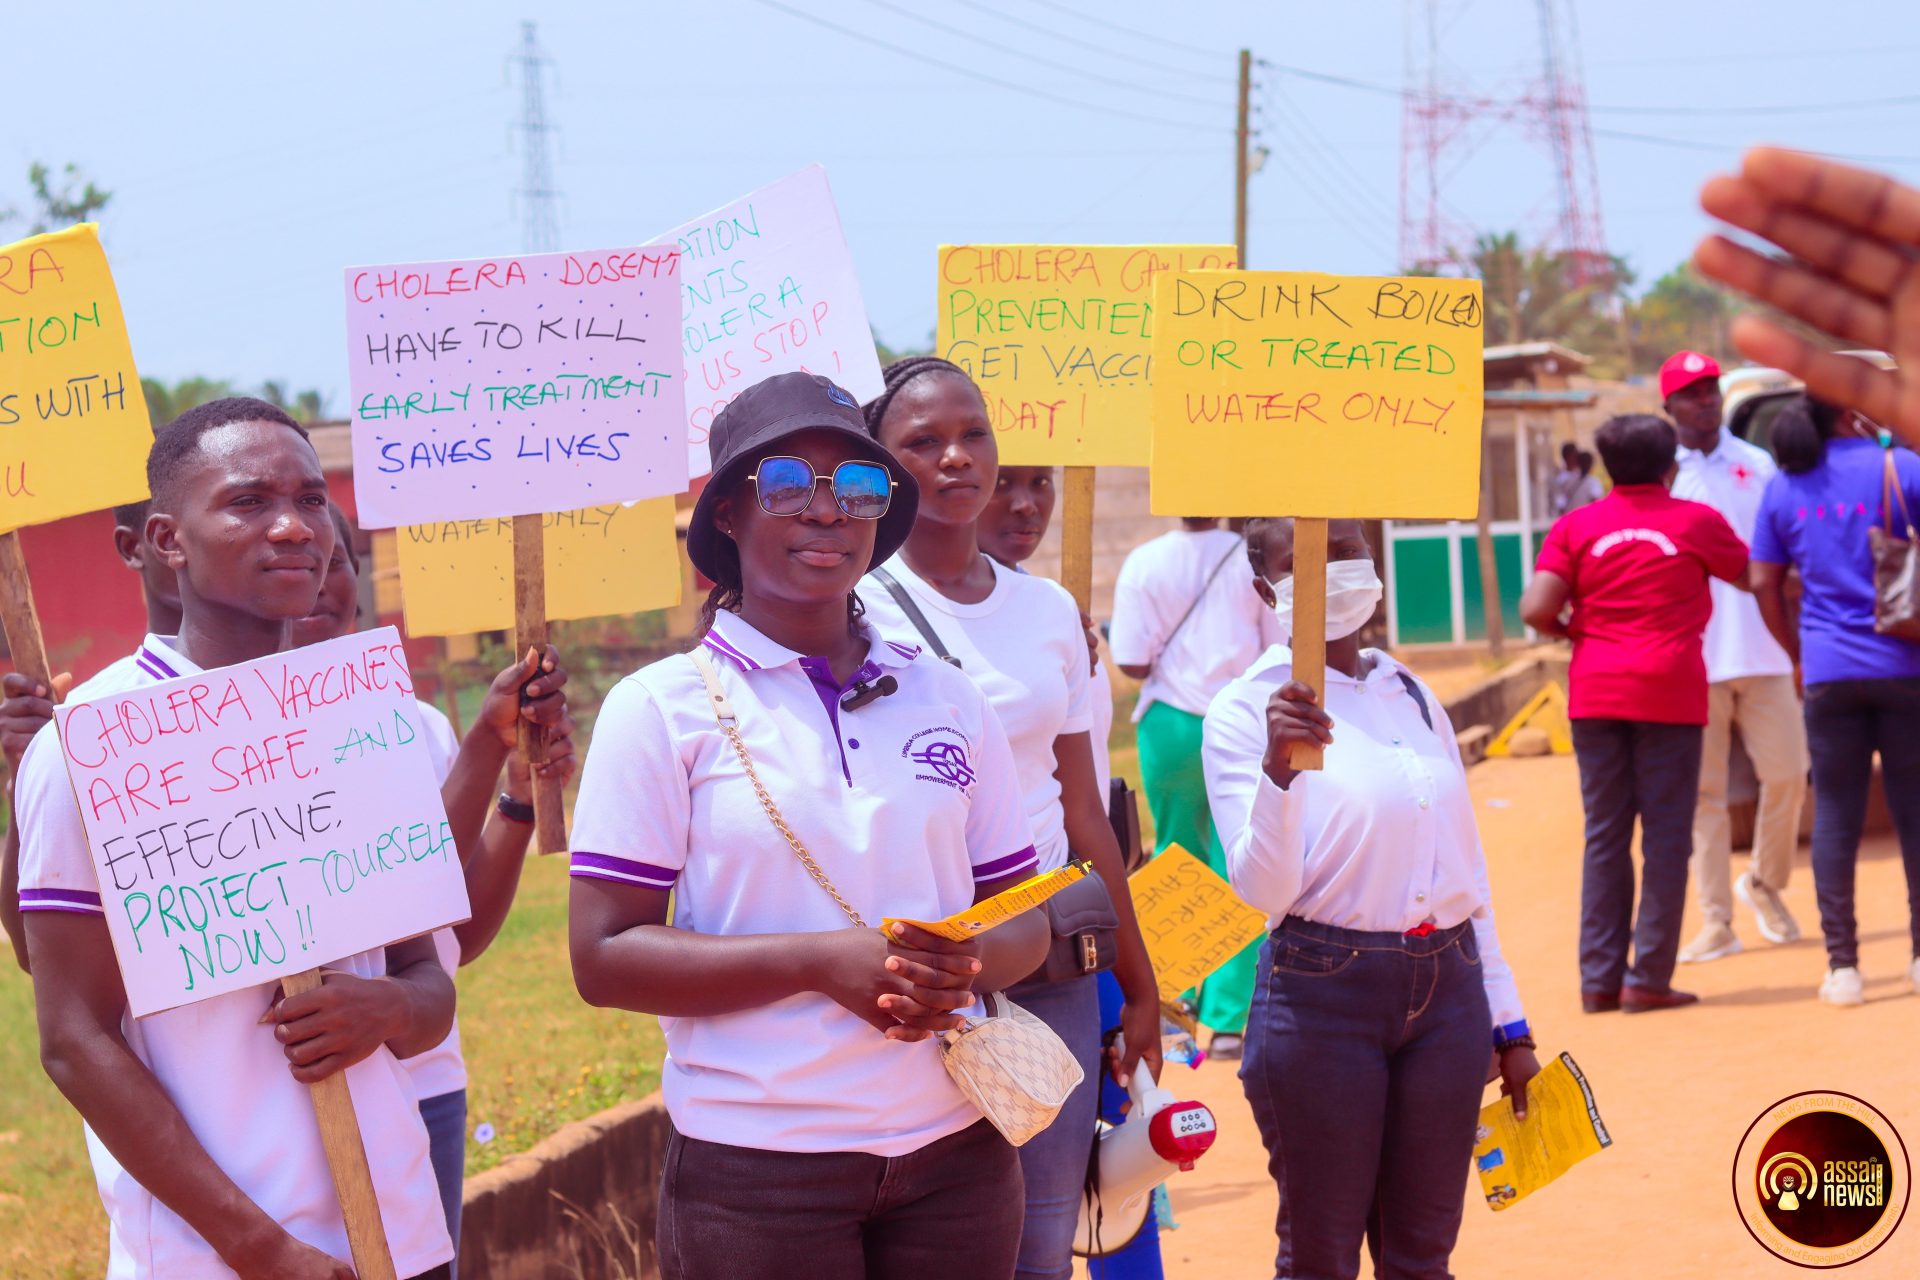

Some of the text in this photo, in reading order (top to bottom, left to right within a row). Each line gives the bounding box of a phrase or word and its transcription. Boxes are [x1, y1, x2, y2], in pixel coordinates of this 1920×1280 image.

[354, 260, 527, 303] CHOLERA
[681, 259, 749, 322] NTS
[942, 245, 1101, 287] CHOLERA
[682, 275, 804, 357] OLERA
[1172, 279, 1482, 328] DRINK BOILED
[366, 316, 646, 365] HAVE TO KILL
[701, 350, 742, 391] US
[753, 300, 829, 363] STOP
[946, 340, 1025, 380] GET
[1177, 337, 1456, 375] OR TREATED
[36, 371, 125, 420] WITH
[357, 371, 673, 420] EARLY TREATMENT
[1185, 391, 1328, 424] WATER
[377, 432, 630, 473] SAVES LIVES
[2, 461, 36, 497] U
[64, 644, 415, 768] CHOLERA VACCINES
[87, 760, 191, 824] ARE
[333, 708, 416, 765] AND
[122, 820, 454, 954] PROTECT YOURSELF
[1135, 861, 1202, 918] SAVE
